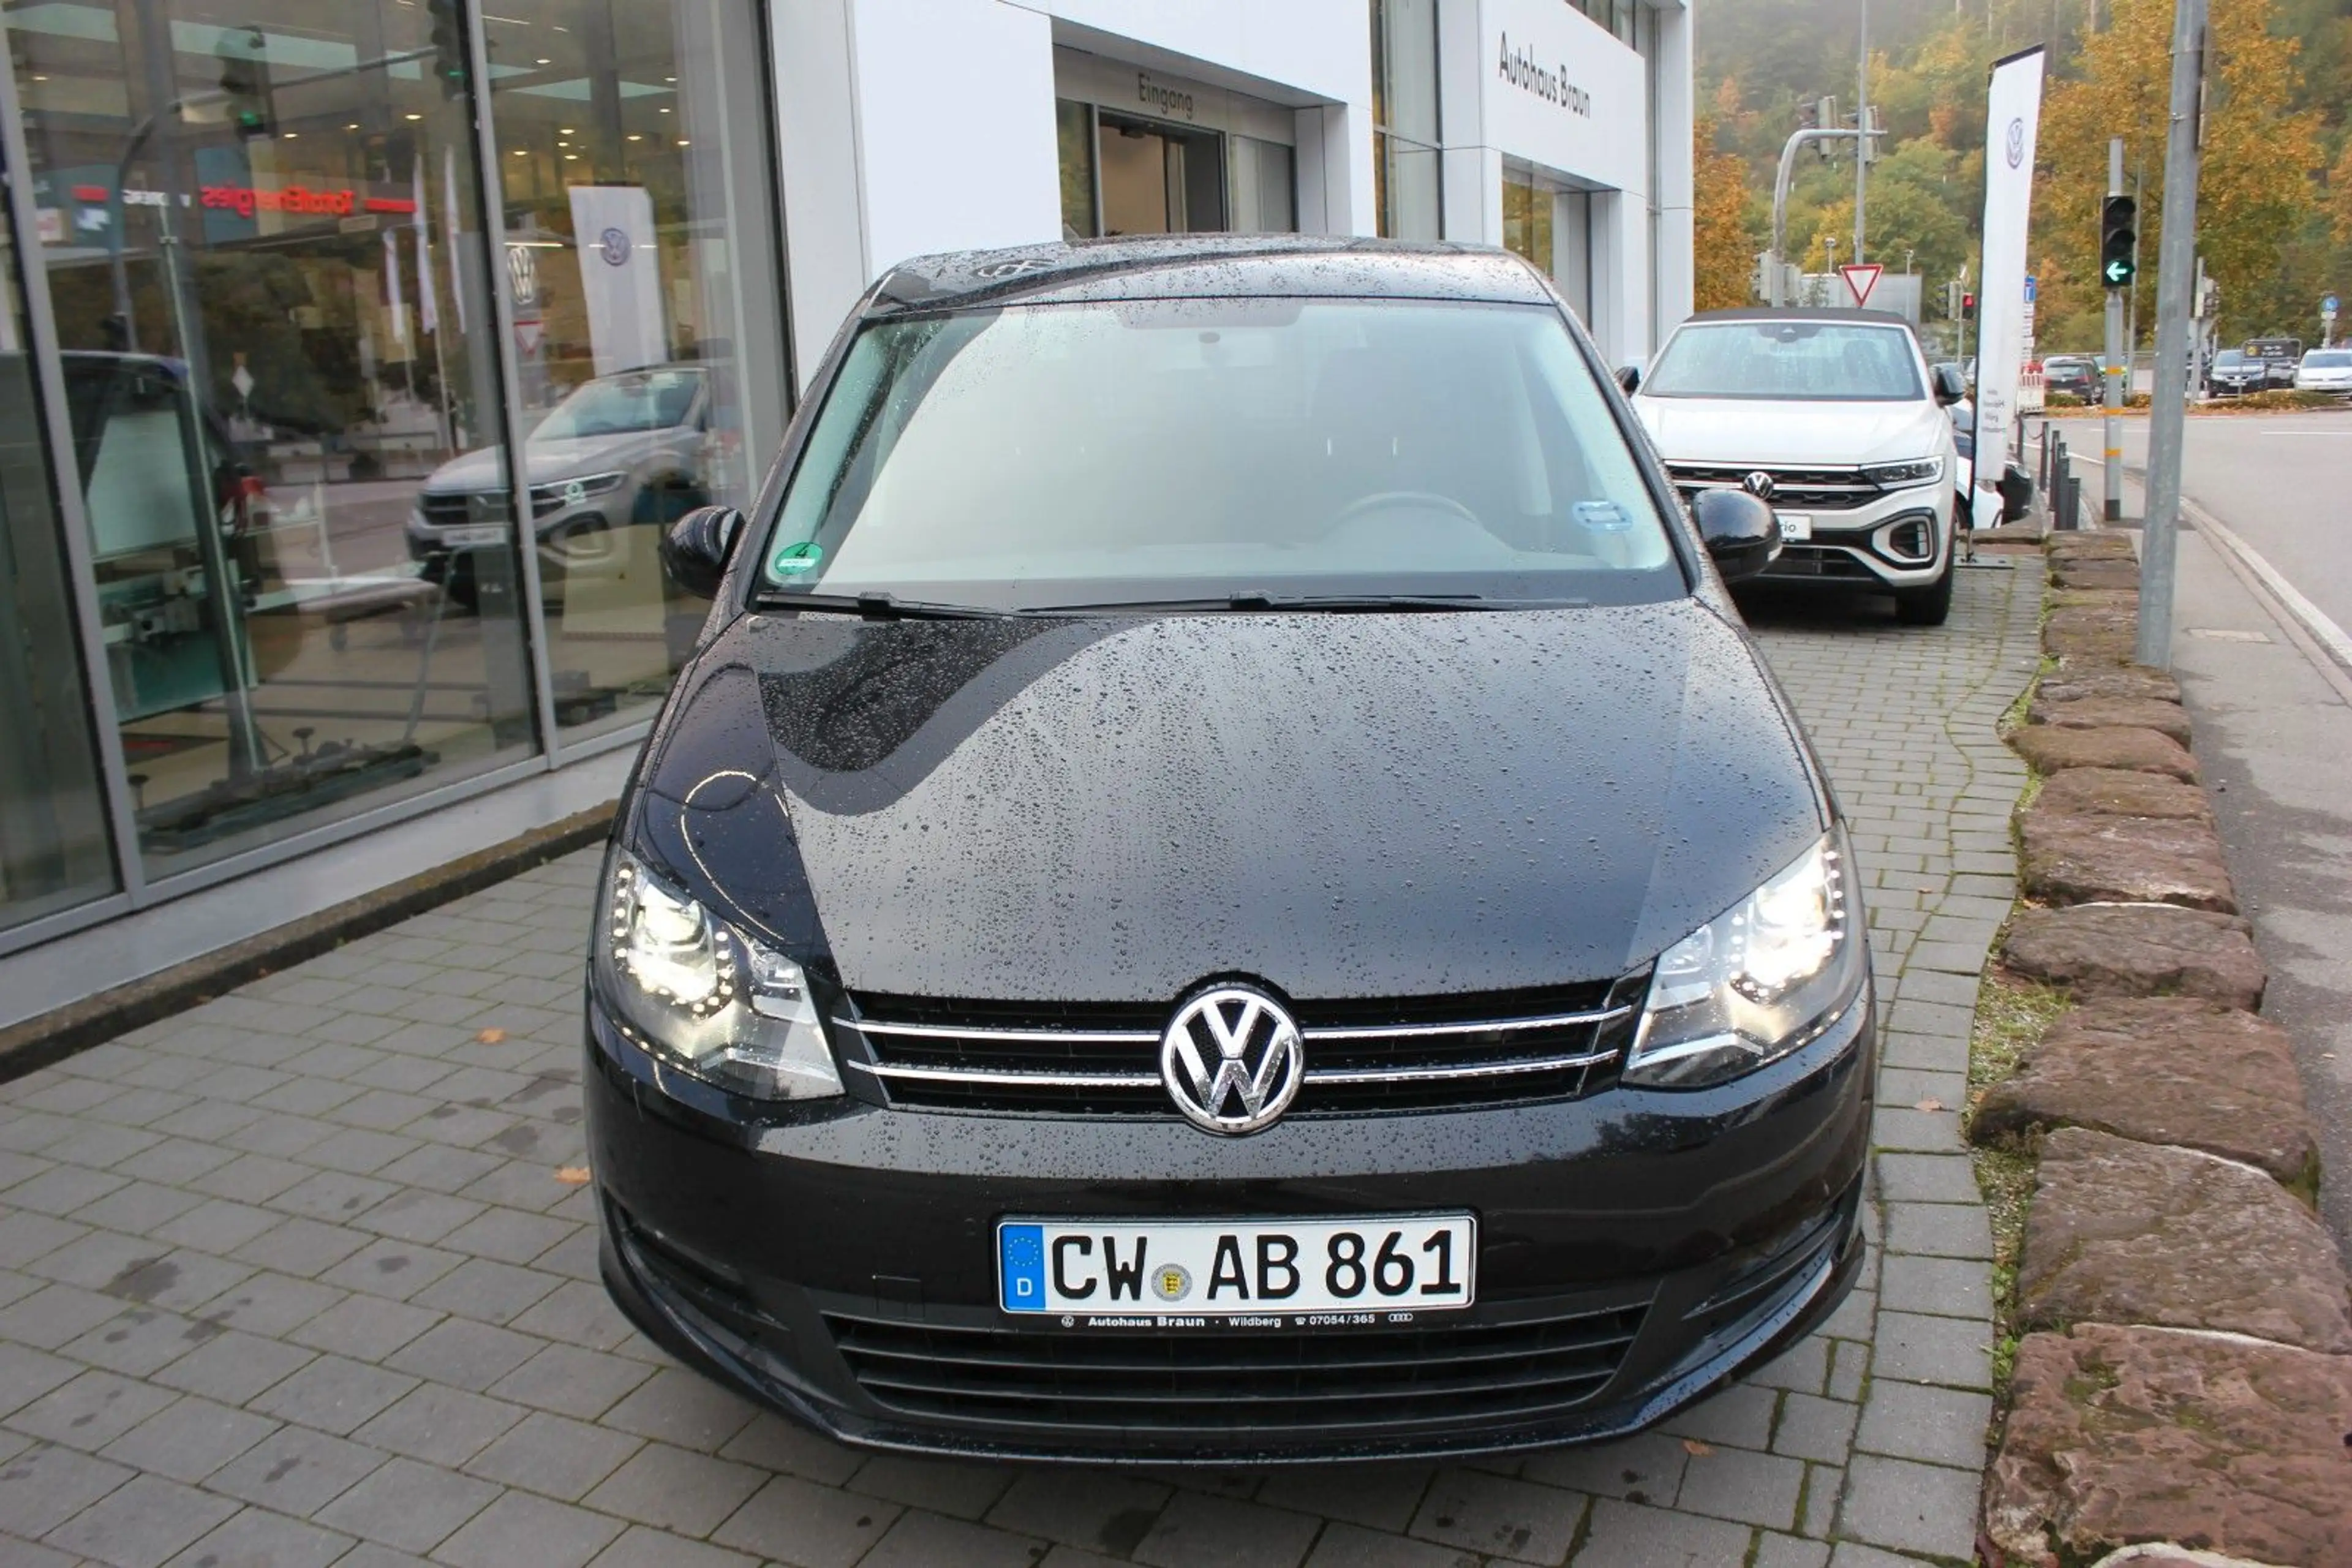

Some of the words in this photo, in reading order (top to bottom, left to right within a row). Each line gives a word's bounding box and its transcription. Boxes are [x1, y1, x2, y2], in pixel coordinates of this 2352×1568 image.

[1139, 73, 1193, 121] Eingang
[1499, 31, 1556, 104] Autohaus
[1560, 64, 1590, 119] Braun
[796, 544, 809, 557] 4
[1161, 989, 1303, 1133] VW
[1017, 1278, 1033, 1296] D
[1052, 1235, 1147, 1300] CW
[1207, 1234, 1300, 1300] AB
[1326, 1230, 1461, 1298] 861
[1088, 1316, 1152, 1327] Autohaus
[1157, 1316, 1205, 1327] Braun
[1229, 1316, 1281, 1328] Wildberg
[1310, 1313, 1376, 1325] 07054/365
